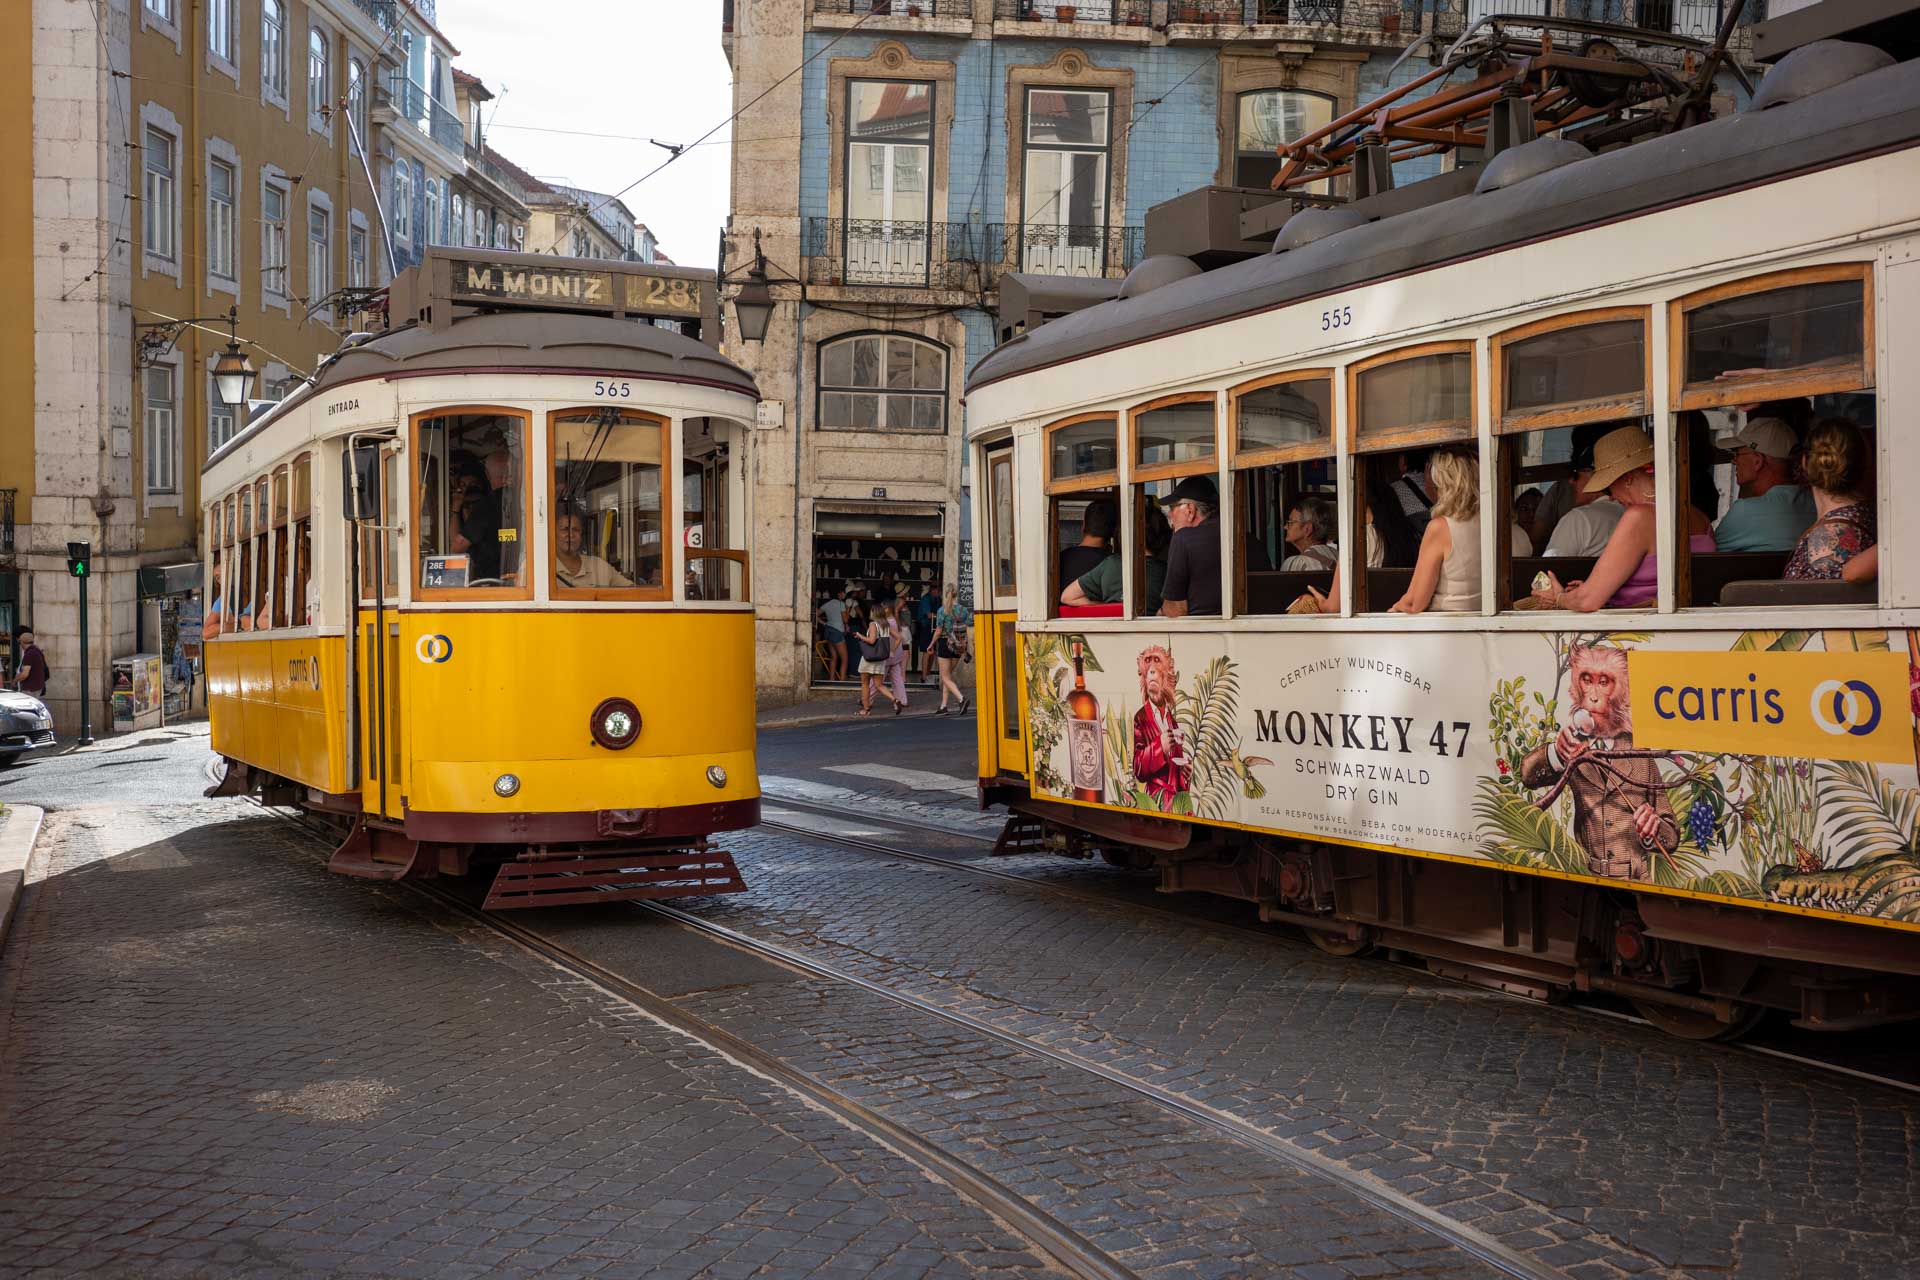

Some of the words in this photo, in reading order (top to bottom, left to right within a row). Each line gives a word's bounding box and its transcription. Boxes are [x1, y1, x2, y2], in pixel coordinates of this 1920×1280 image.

[467, 267, 497, 291] M.
[503, 272, 601, 299] MONIZ
[646, 277, 690, 308] 28
[1322, 306, 1352, 331] 555
[594, 381, 630, 398] 565
[328, 399, 360, 416] ENTRADA
[428, 562, 444, 570] 28E
[428, 575, 443, 586] 14
[1280, 657, 1341, 689] CERTAINLY
[1347, 656, 1432, 694] WUNDERBAR
[1654, 673, 1784, 724] carris
[1254, 709, 1414, 753] MONKEY
[1429, 720, 1471, 758] 47
[1295, 758, 1431, 785] SCHWARZWALD
[1325, 784, 1358, 801] DRY
[1368, 788, 1399, 806] GIN
[1260, 806, 1281, 816] SEJA
[1361, 819, 1386, 830] BEBA
[1391, 823, 1412, 833] COM
[1417, 827, 1482, 843] MODERAÇÃO
